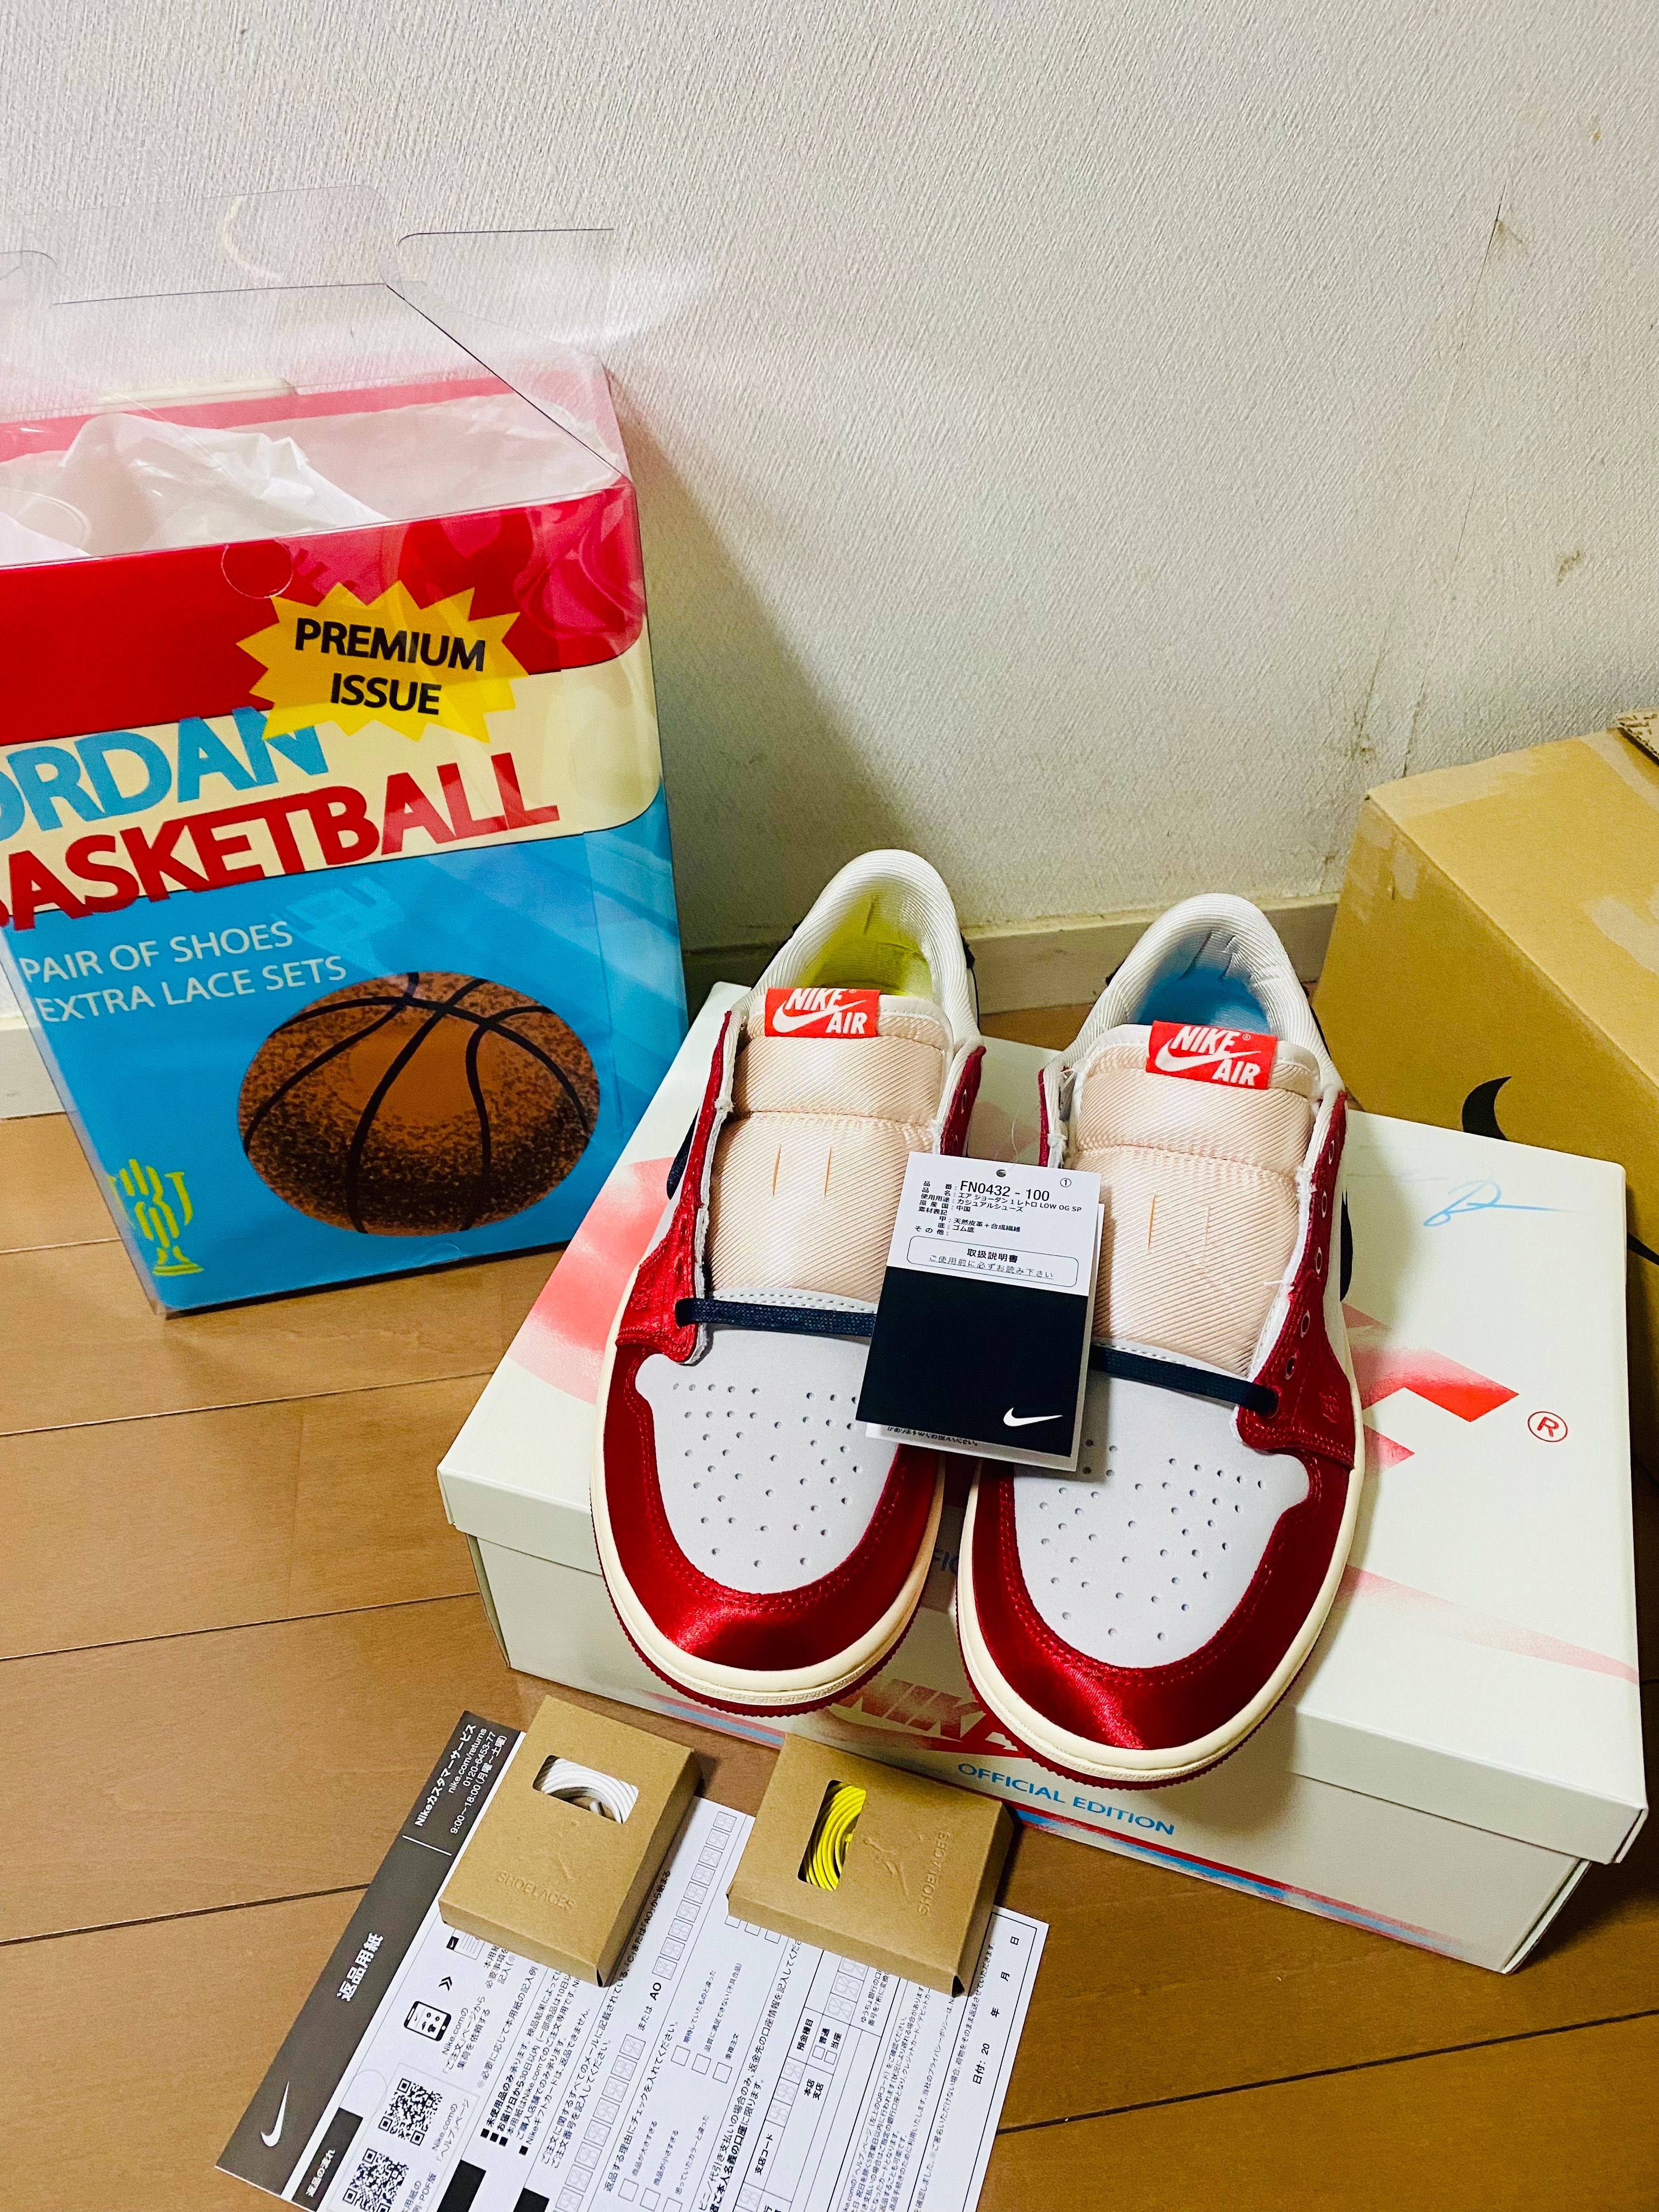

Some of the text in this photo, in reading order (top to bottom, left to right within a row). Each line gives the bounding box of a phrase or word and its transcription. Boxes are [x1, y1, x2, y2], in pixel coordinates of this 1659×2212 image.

[295, 618, 486, 672] PREMIUM
[330, 673, 442, 715] ISSUE
[0, 752, 560, 931] ASKETBALL
[20, 921, 293, 983] PAIR OF SHOES
[36, 955, 347, 1023] EXTRA LACE SETS
[825, 1012, 868, 1035] AIR
[1211, 1059, 1261, 1086] AIR
[960, 1180, 1011, 1197] FN0432
[1026, 1188, 1050, 1201] 100
[952, 1224, 975, 1233] ゴム底
[928, 1255, 1053, 1278] ご使用前に必ずお読み下さい
[967, 1248, 1018, 1263] 取扱説明書
[413, 1722, 477, 1827] Nikeカスタマーサービス
[446, 1727, 488, 1794] nike.com/returns
[462, 1730, 498, 1787] 0120-6453-77
[957, 1763, 1175, 1836] OFFICIAL EDITION
[496, 1870, 575, 1912] SHOELACES
[917, 1831, 950, 1916] SHOELACES
[335, 1931, 384, 2002] 返品用紙
[637, 1981, 663, 2031] または AO
[682, 1969, 716, 2044] 期待していたものと違った
[981, 2042, 990, 2055] 20
[990, 2006, 1001, 2018] 年
[1000, 1971, 1010, 1982] 月
[1010, 1936, 1019, 1945] 日
[441, 2007, 470, 2055] Nike.comの
[443, 1995, 486, 2075] 「ご注文」ページから
[456, 2007, 491, 2070] 集荷を依頼する
[725, 2032, 740, 2061] 重複注文
[797, 2018, 814, 2051] 預金種目
[818, 2027, 830, 2045] 普通
[830, 2031, 842, 2050] 当座
[550, 2038, 612, 2170] ご注文番号を記入してください。
[603, 2018, 678, 2193] 返品する理由にチェックを入れてください。
[803, 2078, 815, 2097] 本店
[811, 2081, 824, 2101] 支店
[431, 2102, 459, 2152] Nike.comの
[631, 2120, 658, 2176] 商品が大きすぎる
[305, 2147, 337, 2197] 返品の流れ
[653, 2129, 679, 2186] 商品が小さすぎる
[754, 2133, 774, 2175] 支店コード
